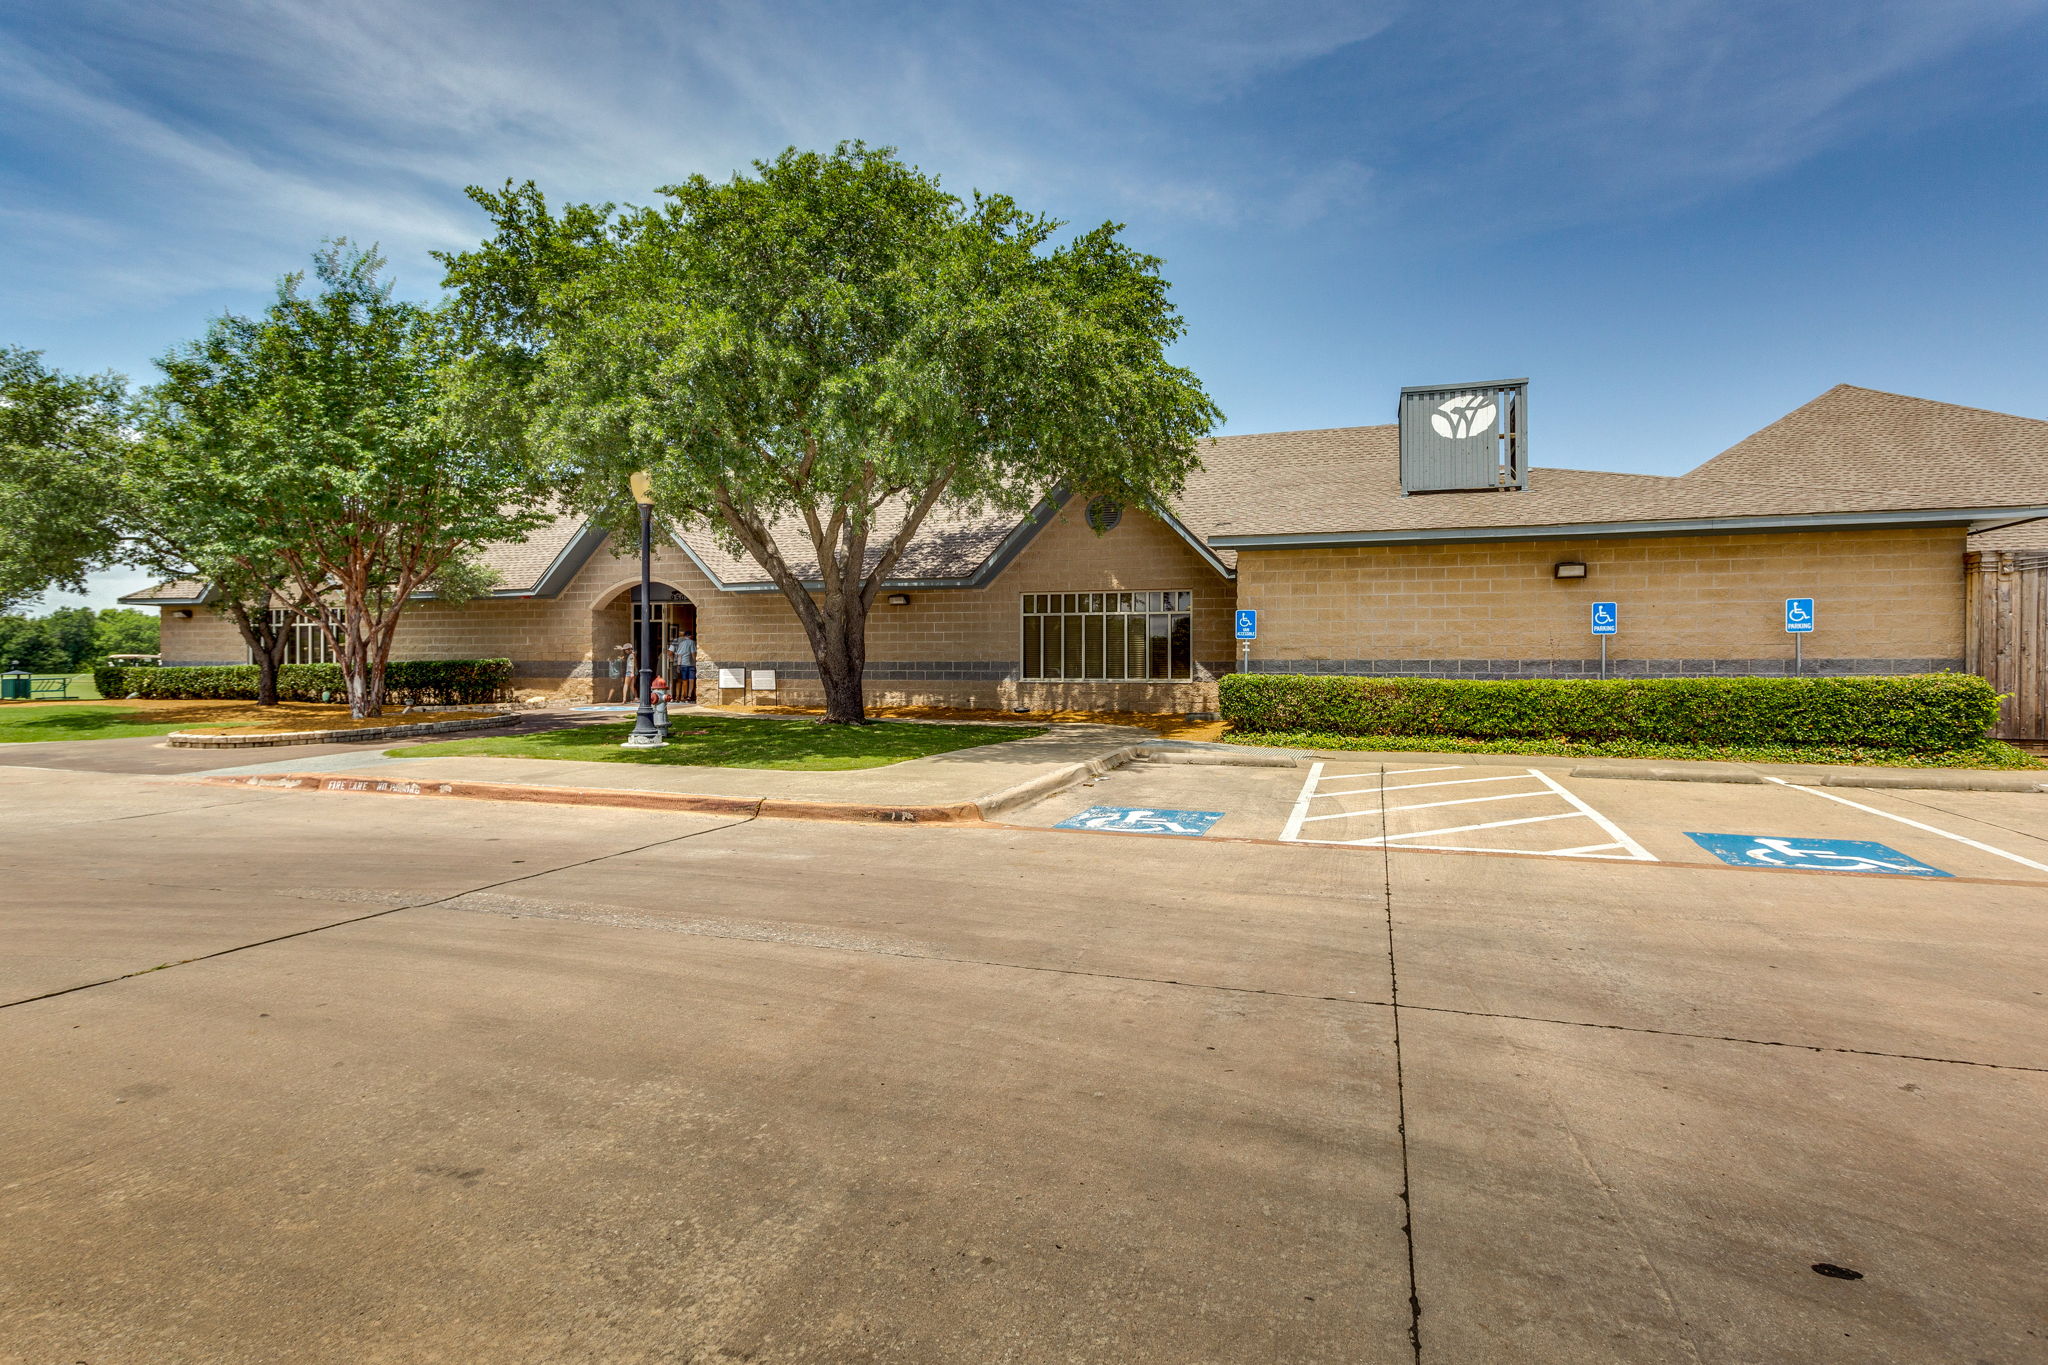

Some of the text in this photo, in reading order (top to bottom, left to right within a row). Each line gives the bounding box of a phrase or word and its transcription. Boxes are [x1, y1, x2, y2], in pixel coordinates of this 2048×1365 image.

[327, 780, 346, 790] FIRE
[348, 781, 368, 791] LANE
[376, 782, 388, 791] NO
